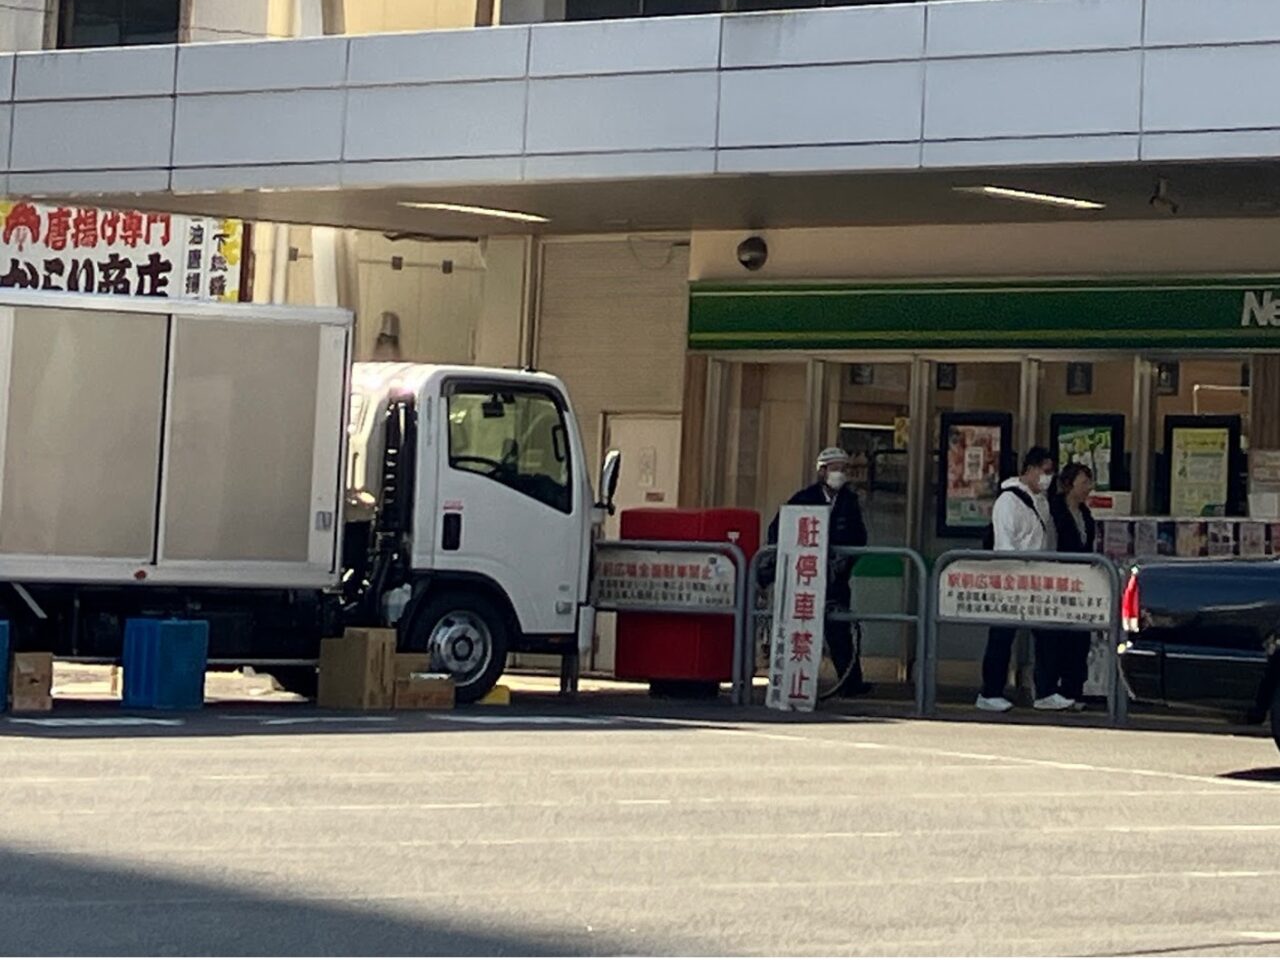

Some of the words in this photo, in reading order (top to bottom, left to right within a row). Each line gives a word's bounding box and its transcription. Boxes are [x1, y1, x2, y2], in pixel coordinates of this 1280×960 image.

[788, 516, 820, 700] 駐停車禁止
